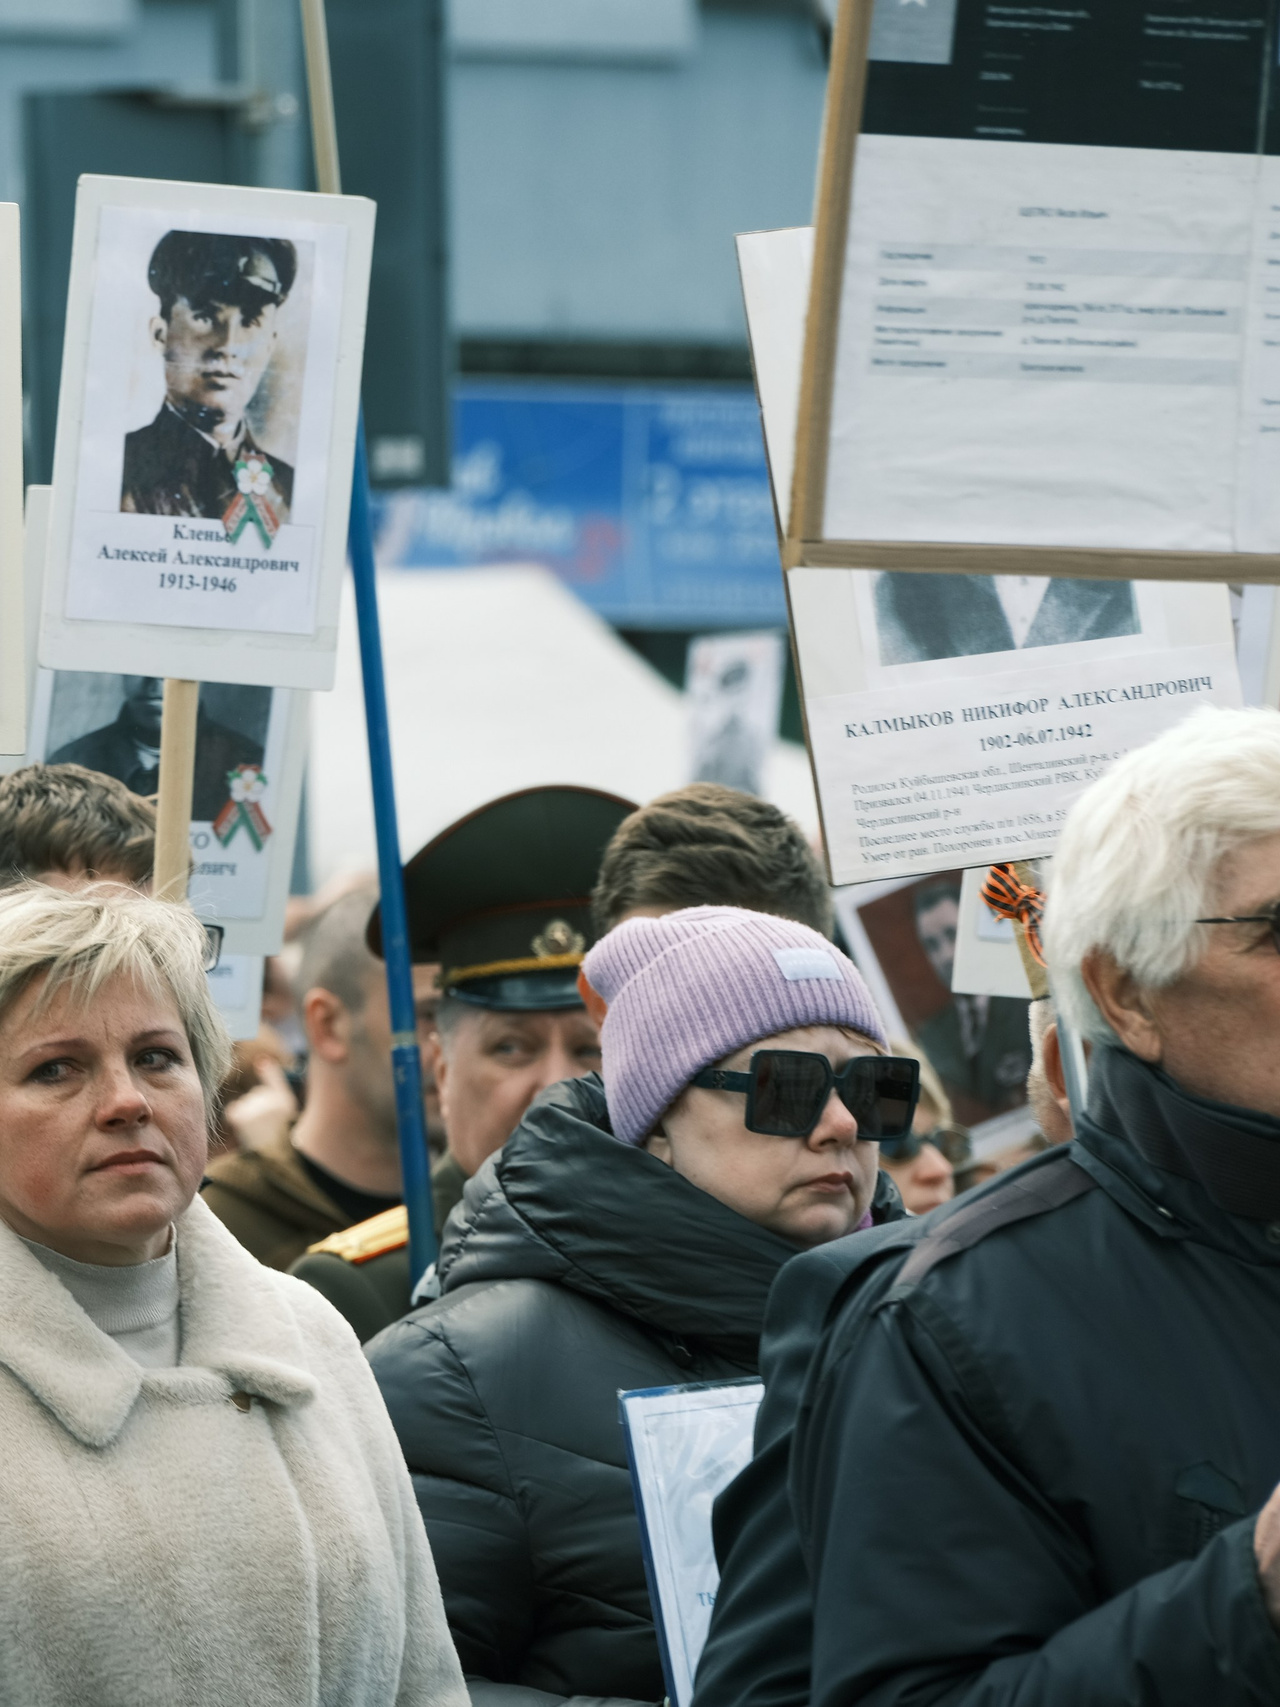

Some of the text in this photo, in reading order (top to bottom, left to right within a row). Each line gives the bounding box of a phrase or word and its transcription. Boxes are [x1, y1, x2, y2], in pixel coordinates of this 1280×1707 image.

[97, 545, 299, 573] Алексей Александрович
[158, 573, 237, 593] 1913-1946
[845, 676, 1213, 738] КАЛМЫКОВ НИКИФОР АЛЕКСАНДРОВИЧ
[980, 724, 1093, 751] 1902-06.07.1942
